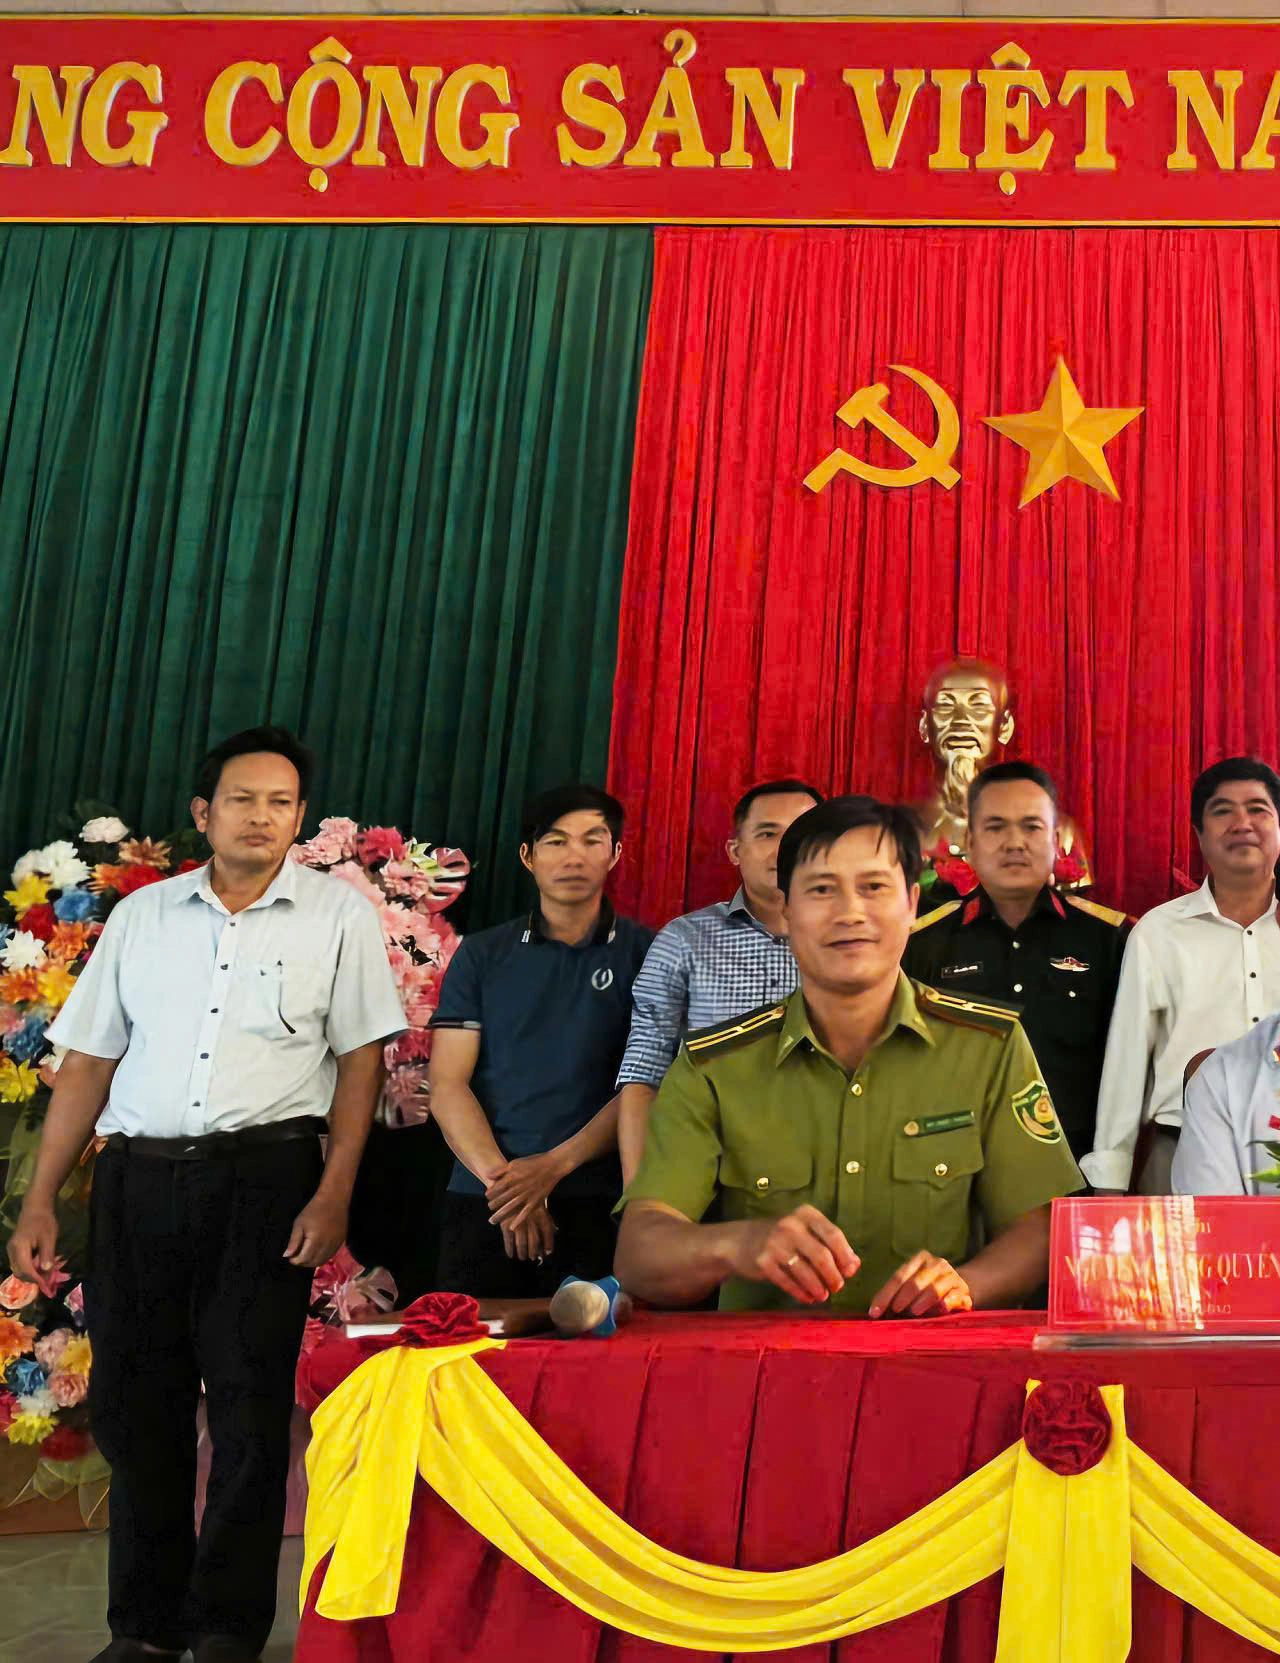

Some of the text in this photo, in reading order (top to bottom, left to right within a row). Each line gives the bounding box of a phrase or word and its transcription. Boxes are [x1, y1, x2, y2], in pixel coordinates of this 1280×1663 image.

[0, 62, 168, 168] NG
[204, 36, 520, 193] CỘNG
[557, 28, 806, 170] SẢN
[842, 41, 1135, 196] VIỆT
